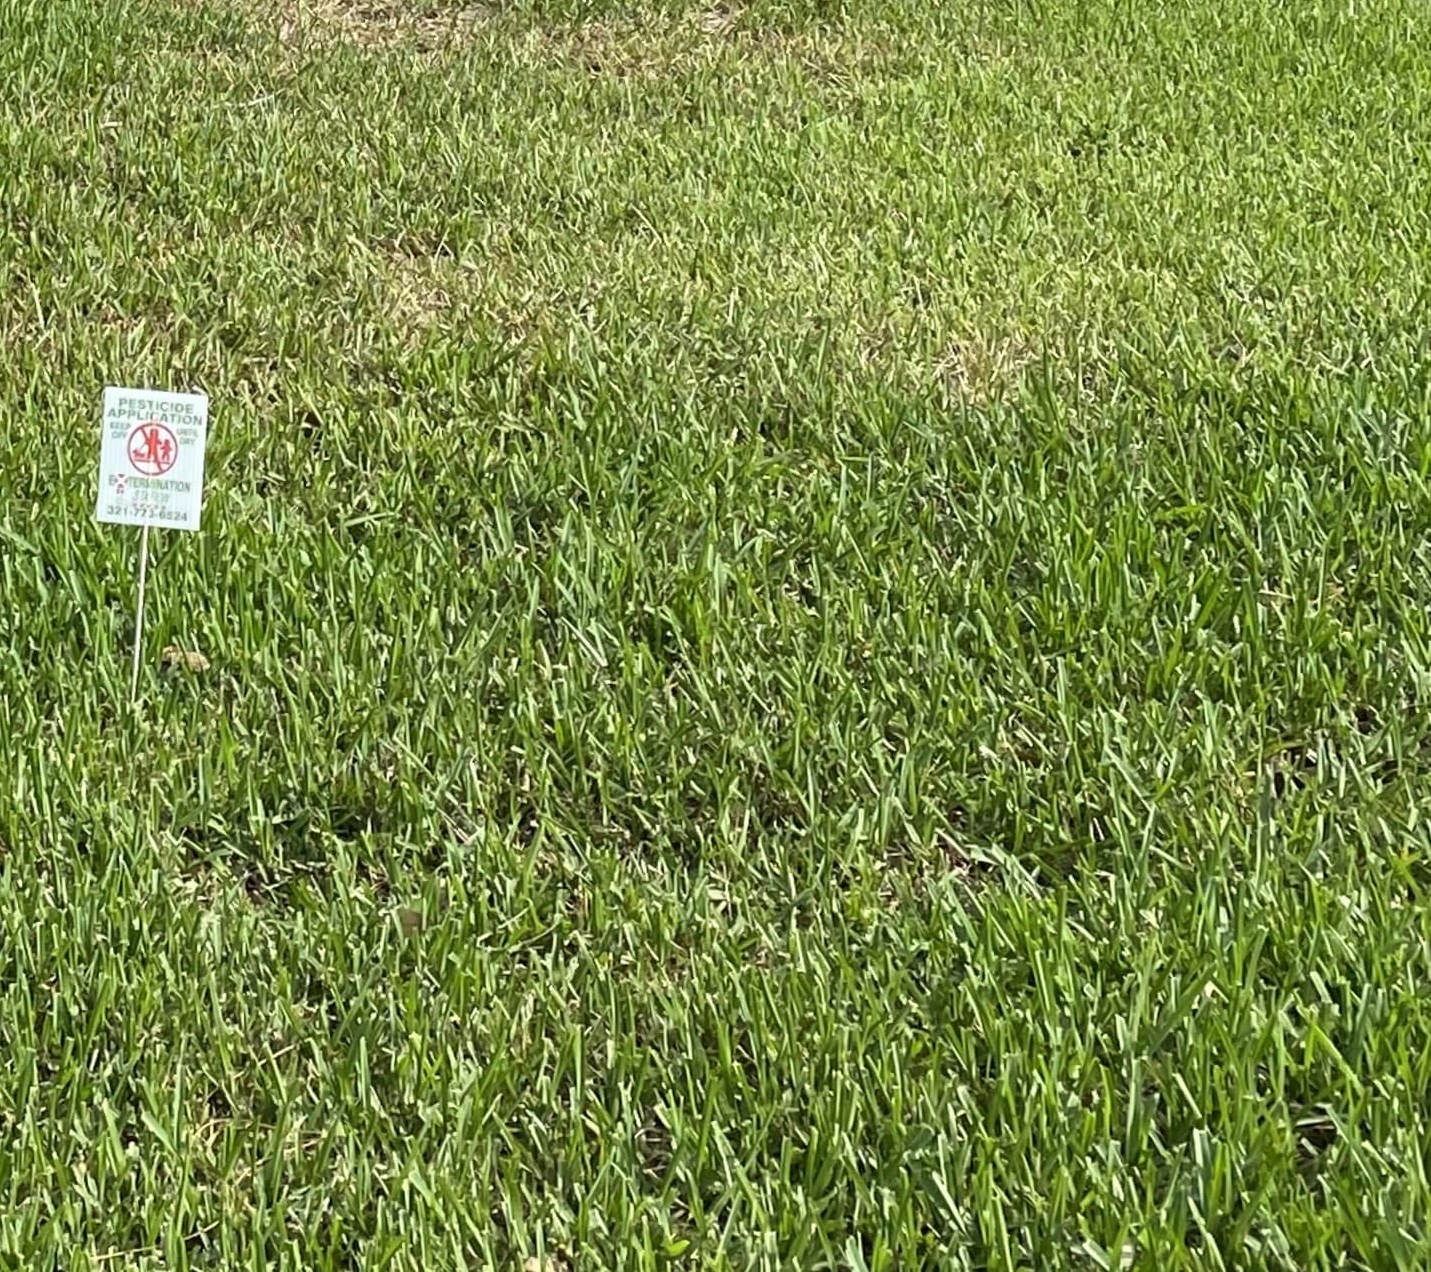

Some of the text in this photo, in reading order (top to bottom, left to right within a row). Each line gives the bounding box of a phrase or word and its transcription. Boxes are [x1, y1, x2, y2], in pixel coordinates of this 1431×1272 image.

[119, 397, 194, 414] PESTICIDE
[107, 409, 202, 425] APPLICATION
[110, 421, 130, 430] KEEP
[111, 431, 128, 439] OFF
[179, 437, 196, 445] DRY
